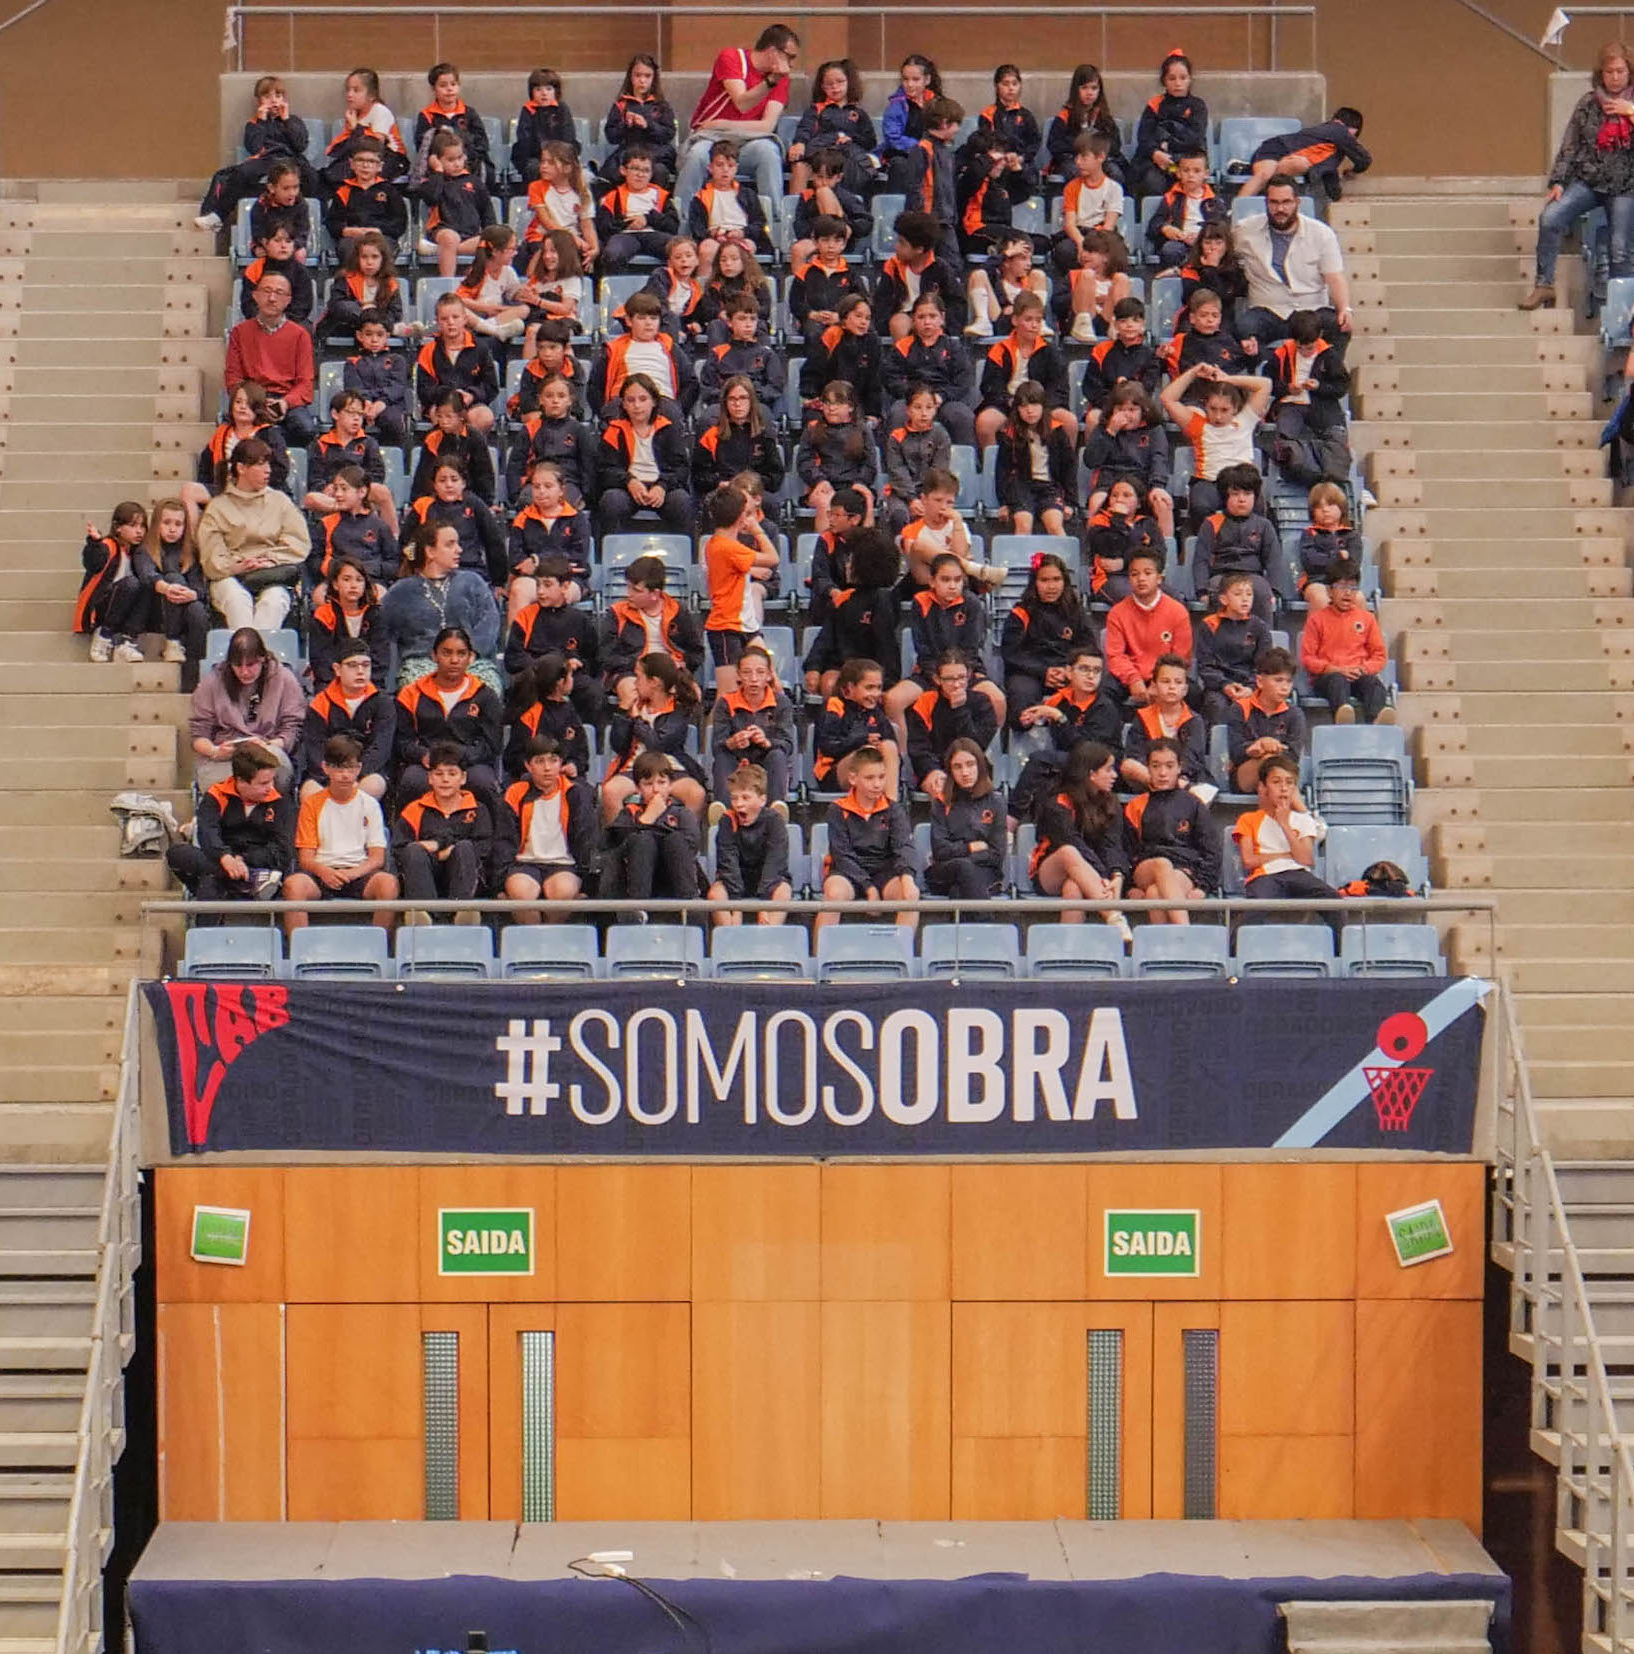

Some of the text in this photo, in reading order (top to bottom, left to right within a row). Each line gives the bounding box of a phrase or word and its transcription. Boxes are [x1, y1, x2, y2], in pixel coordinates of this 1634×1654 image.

[495, 1007, 1138, 1126] #SOMOSOBRA
[447, 1228, 526, 1261] SAIDA
[1112, 1229, 1192, 1262] SAIDA
